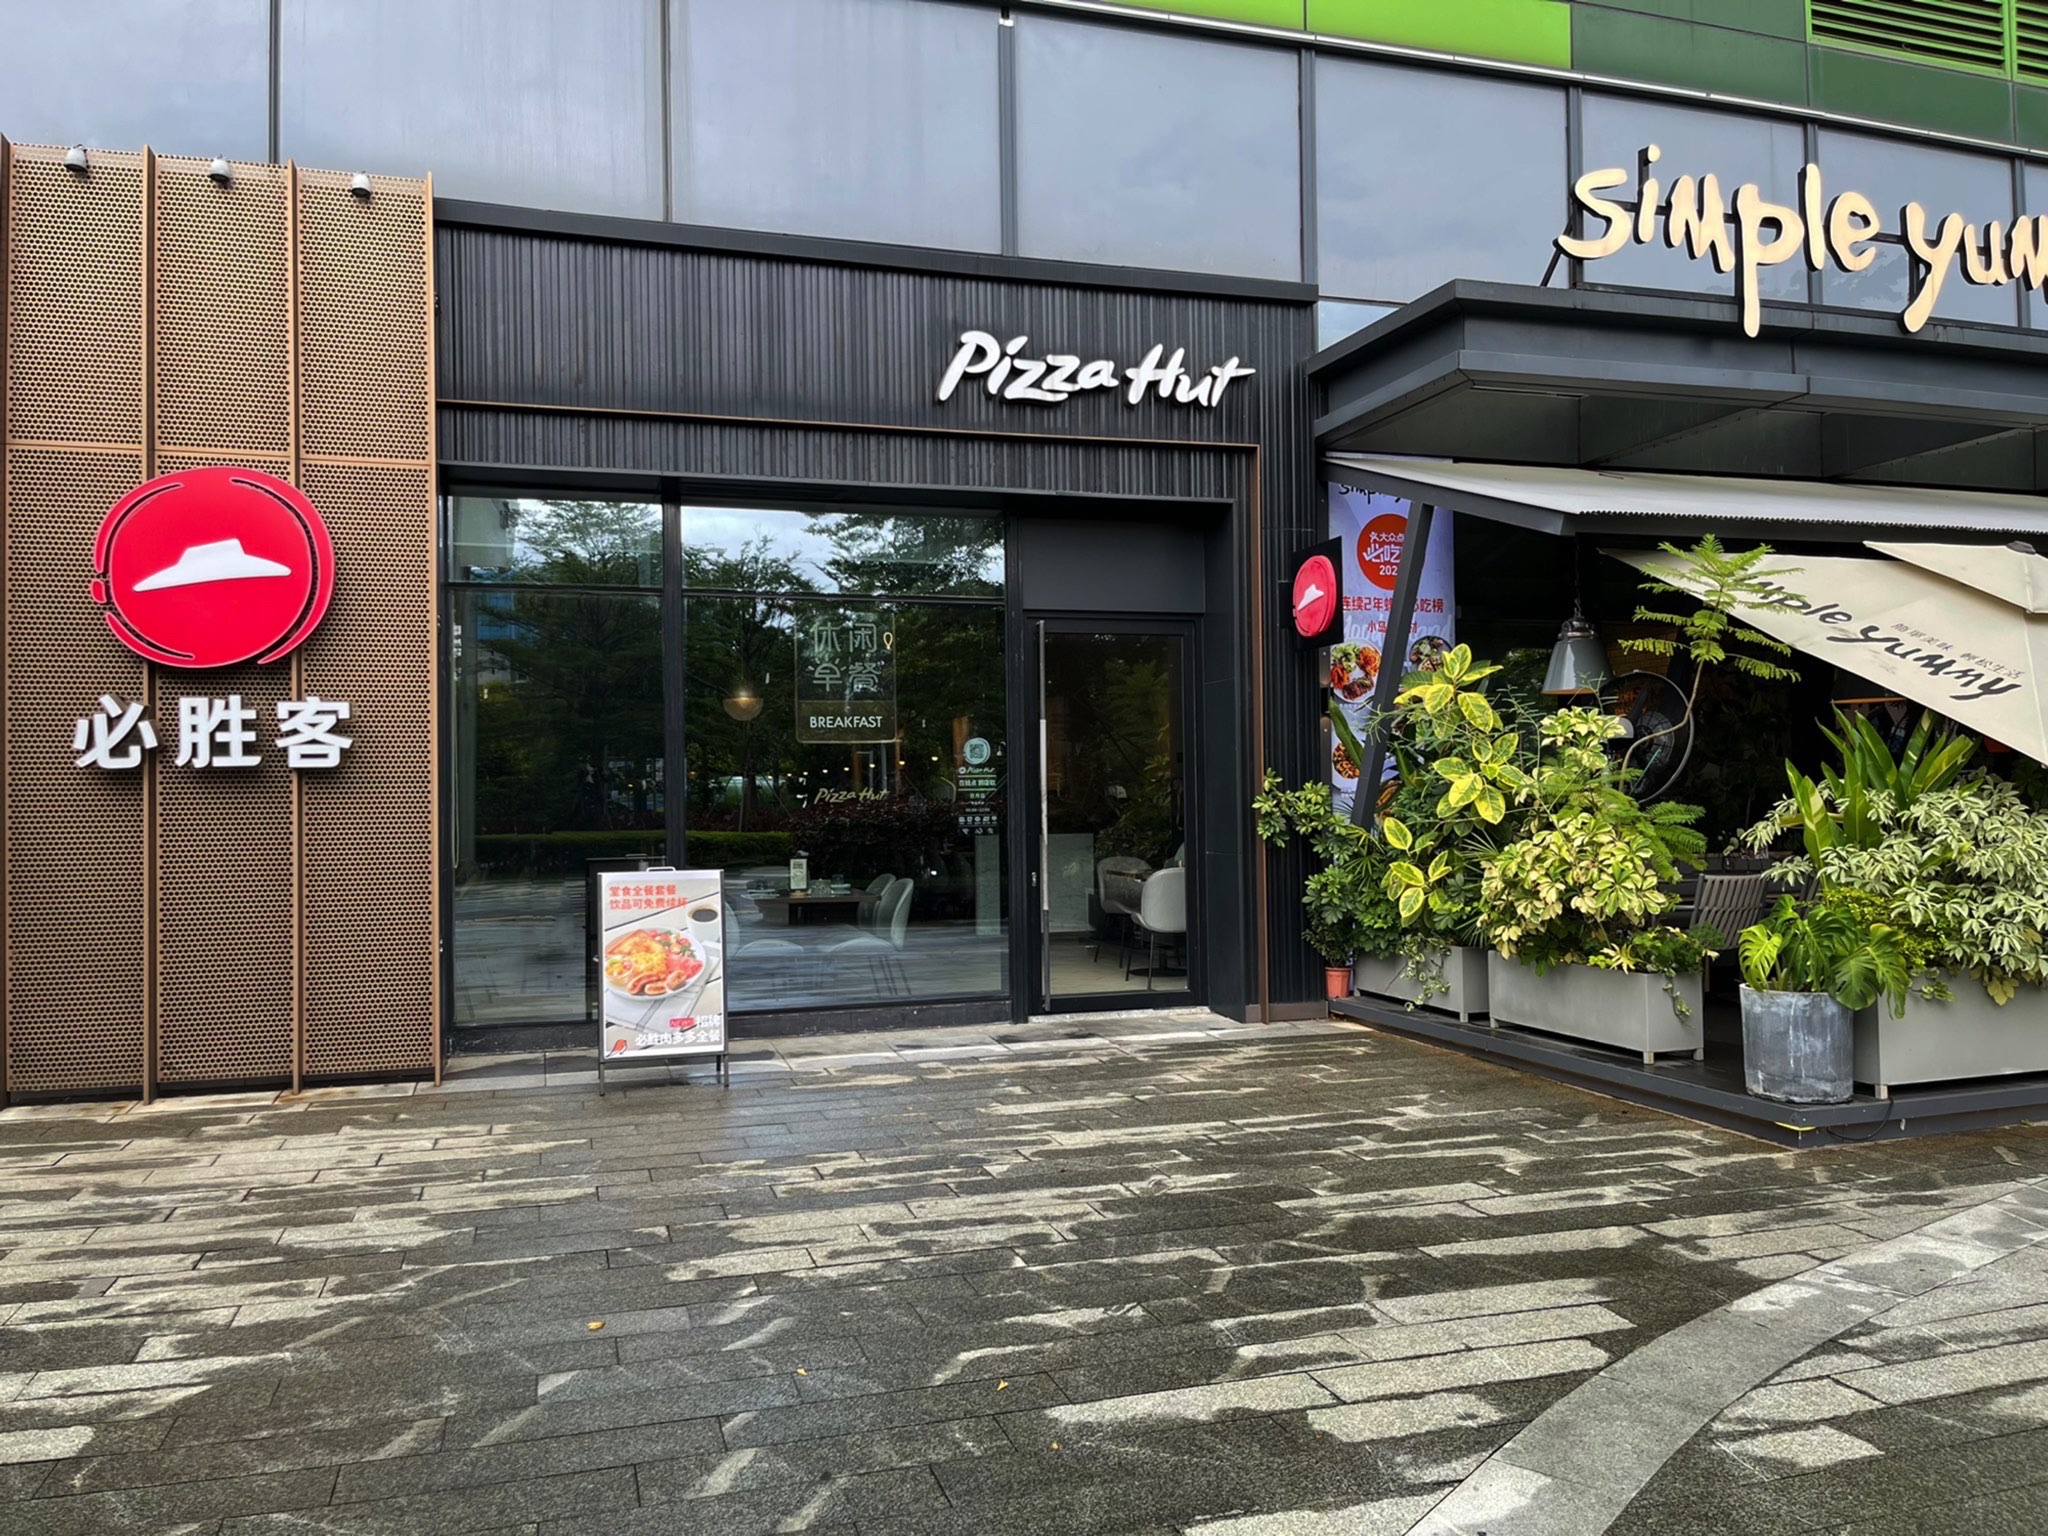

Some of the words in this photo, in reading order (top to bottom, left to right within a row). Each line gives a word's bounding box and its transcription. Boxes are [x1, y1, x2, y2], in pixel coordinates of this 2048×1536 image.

[1558, 144, 1881, 338] simple
[936, 329, 1119, 403] Pizza
[1124, 342, 1256, 408] Hut
[810, 621, 878, 653] 休闲
[1826, 625, 2022, 701] yummy
[809, 659, 882, 692] 早餐
[72, 694, 354, 770] 必胜客
[809, 716, 883, 728] BREAKFAST
[813, 787, 857, 805] Pizza
[858, 786, 891, 803] Hut
